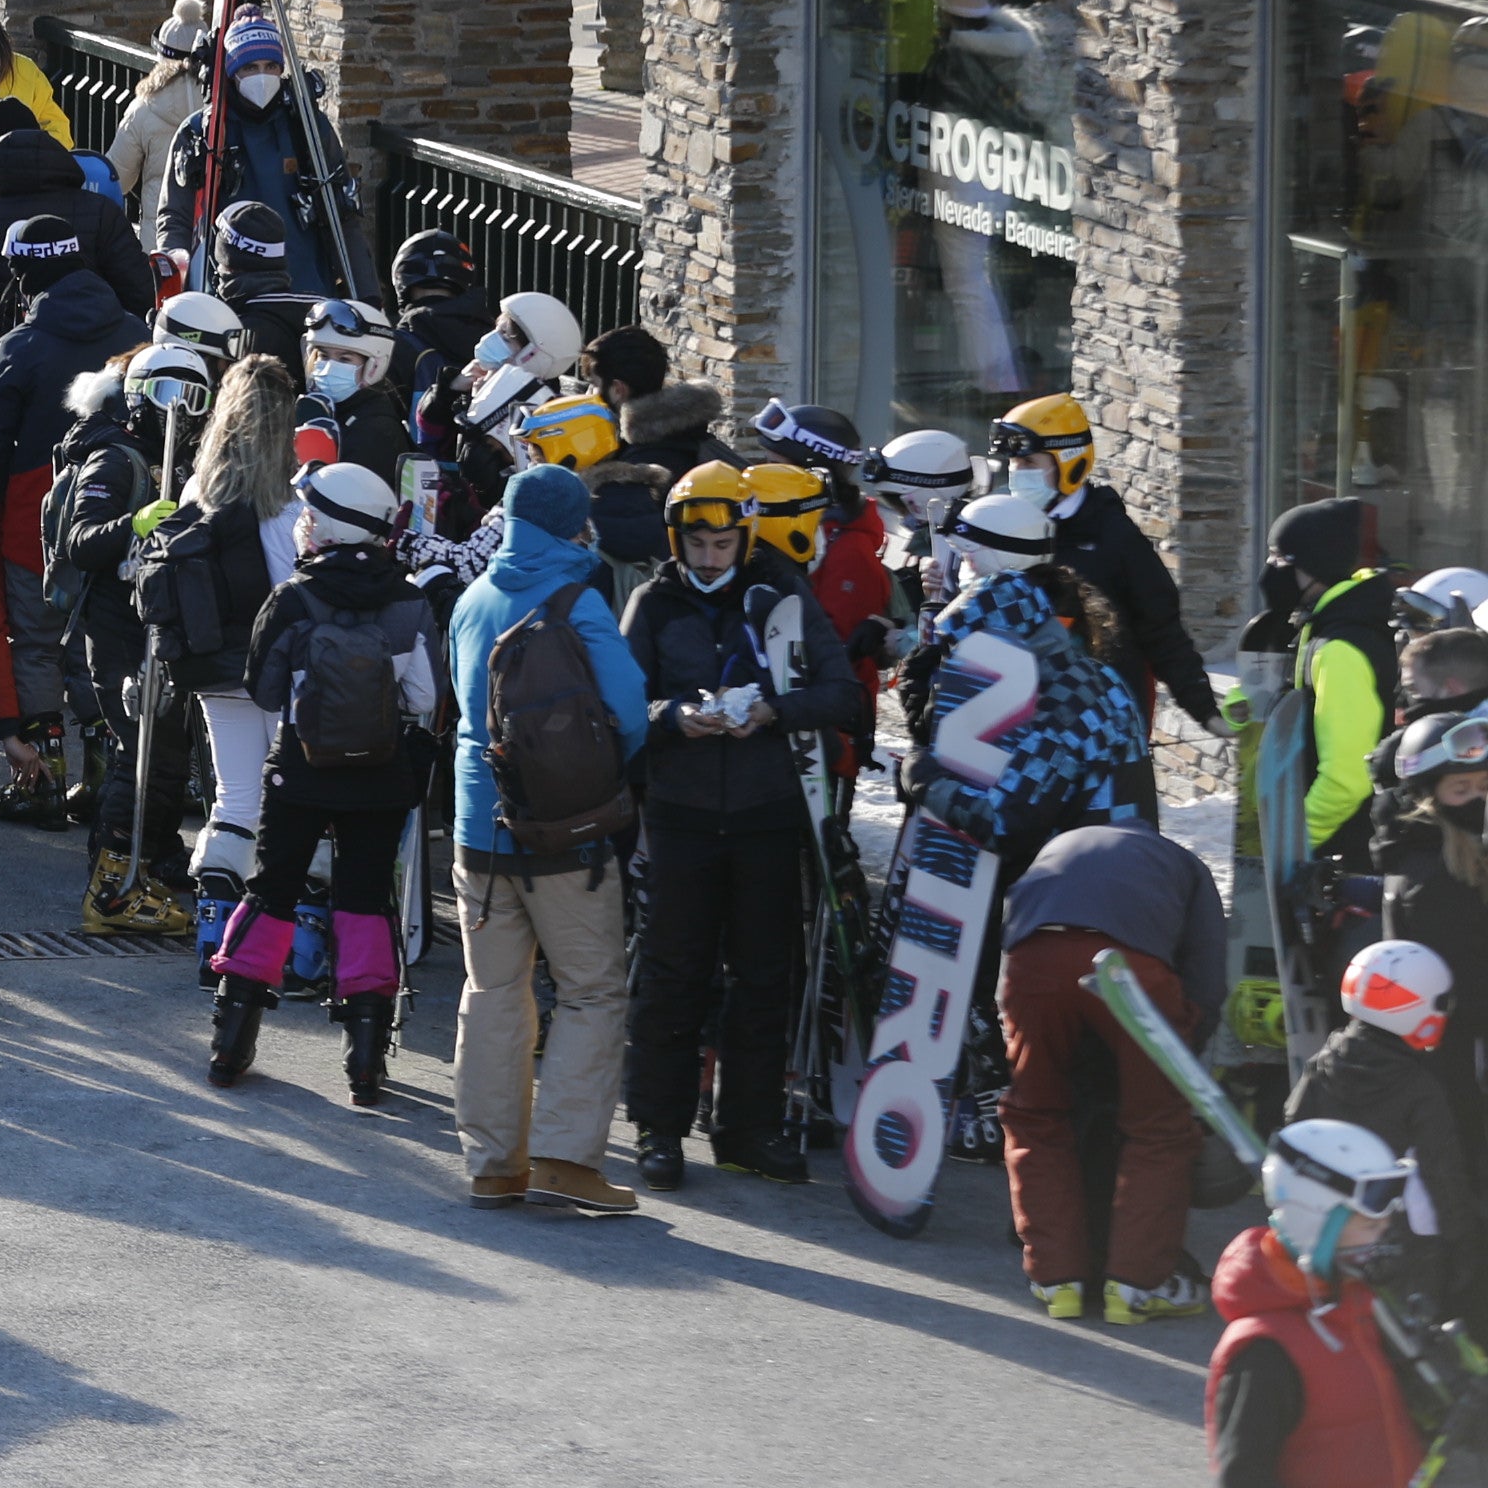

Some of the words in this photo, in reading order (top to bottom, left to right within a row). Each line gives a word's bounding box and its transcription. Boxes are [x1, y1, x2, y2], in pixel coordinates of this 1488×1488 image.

[887, 100, 1074, 212] CEROGRAD
[886, 174, 931, 216] Sierra
[933, 188, 993, 237] Nevada
[1005, 210, 1075, 261] Baqueira
[853, 629, 1038, 1211] NTRO
